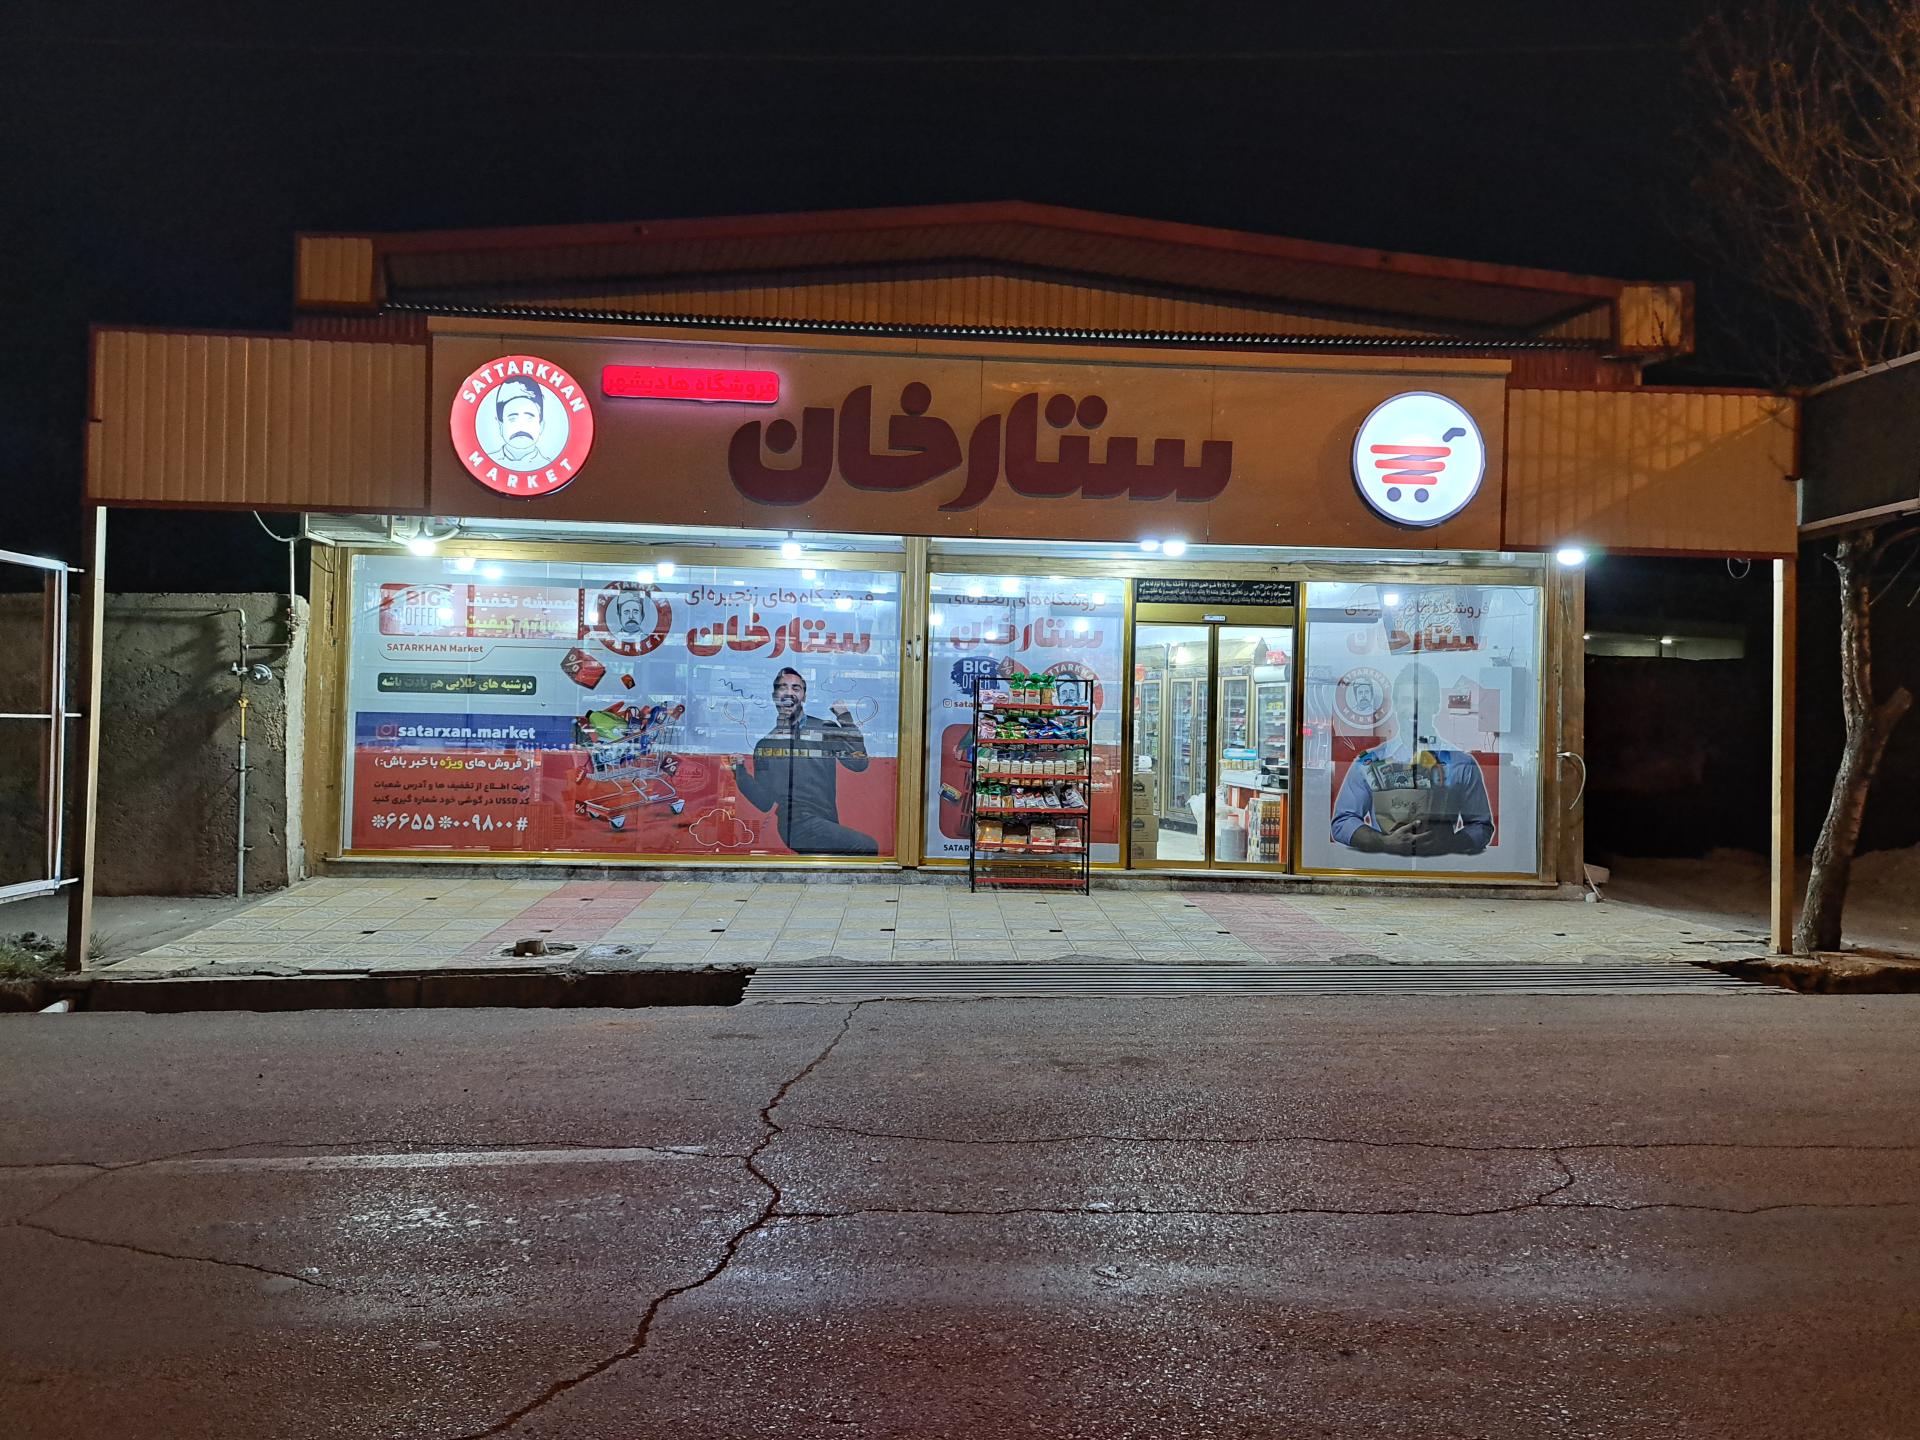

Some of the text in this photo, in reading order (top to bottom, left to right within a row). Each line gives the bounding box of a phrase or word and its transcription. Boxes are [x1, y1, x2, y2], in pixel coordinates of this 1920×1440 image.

[461, 359, 585, 413] SATTARKHAN
[727, 381, 1233, 512] ستارخان
[468, 450, 573, 489] MARKET
[405, 590, 441, 606] BIG
[466, 592, 519, 612] تخفیف
[686, 612, 871, 659] ستارخان
[949, 615, 1105, 653] ستارخان
[386, 643, 484, 653] SATARKHAN Market
[962, 660, 991, 674] BIG
[381, 676, 402, 687] باشه
[429, 679, 444, 690] هم
[445, 677, 477, 691] طلایی
[478, 678, 498, 691] های
[500, 678, 533, 692] دوشنبه
[397, 725, 536, 740] satarxan.market
[439, 757, 464, 770] ویژه
[464, 757, 487, 770] های
[487, 757, 522, 771] فروش
[523, 758, 534, 771] از
[373, 780, 402, 789] شعبات
[403, 779, 427, 791] آدرس
[434, 781, 445, 789] ها
[447, 781, 475, 791] تخفیف
[511, 782, 531, 792] جهت
[372, 793, 530, 806] کد USSD در گوشی خود شماره گیری کنید
